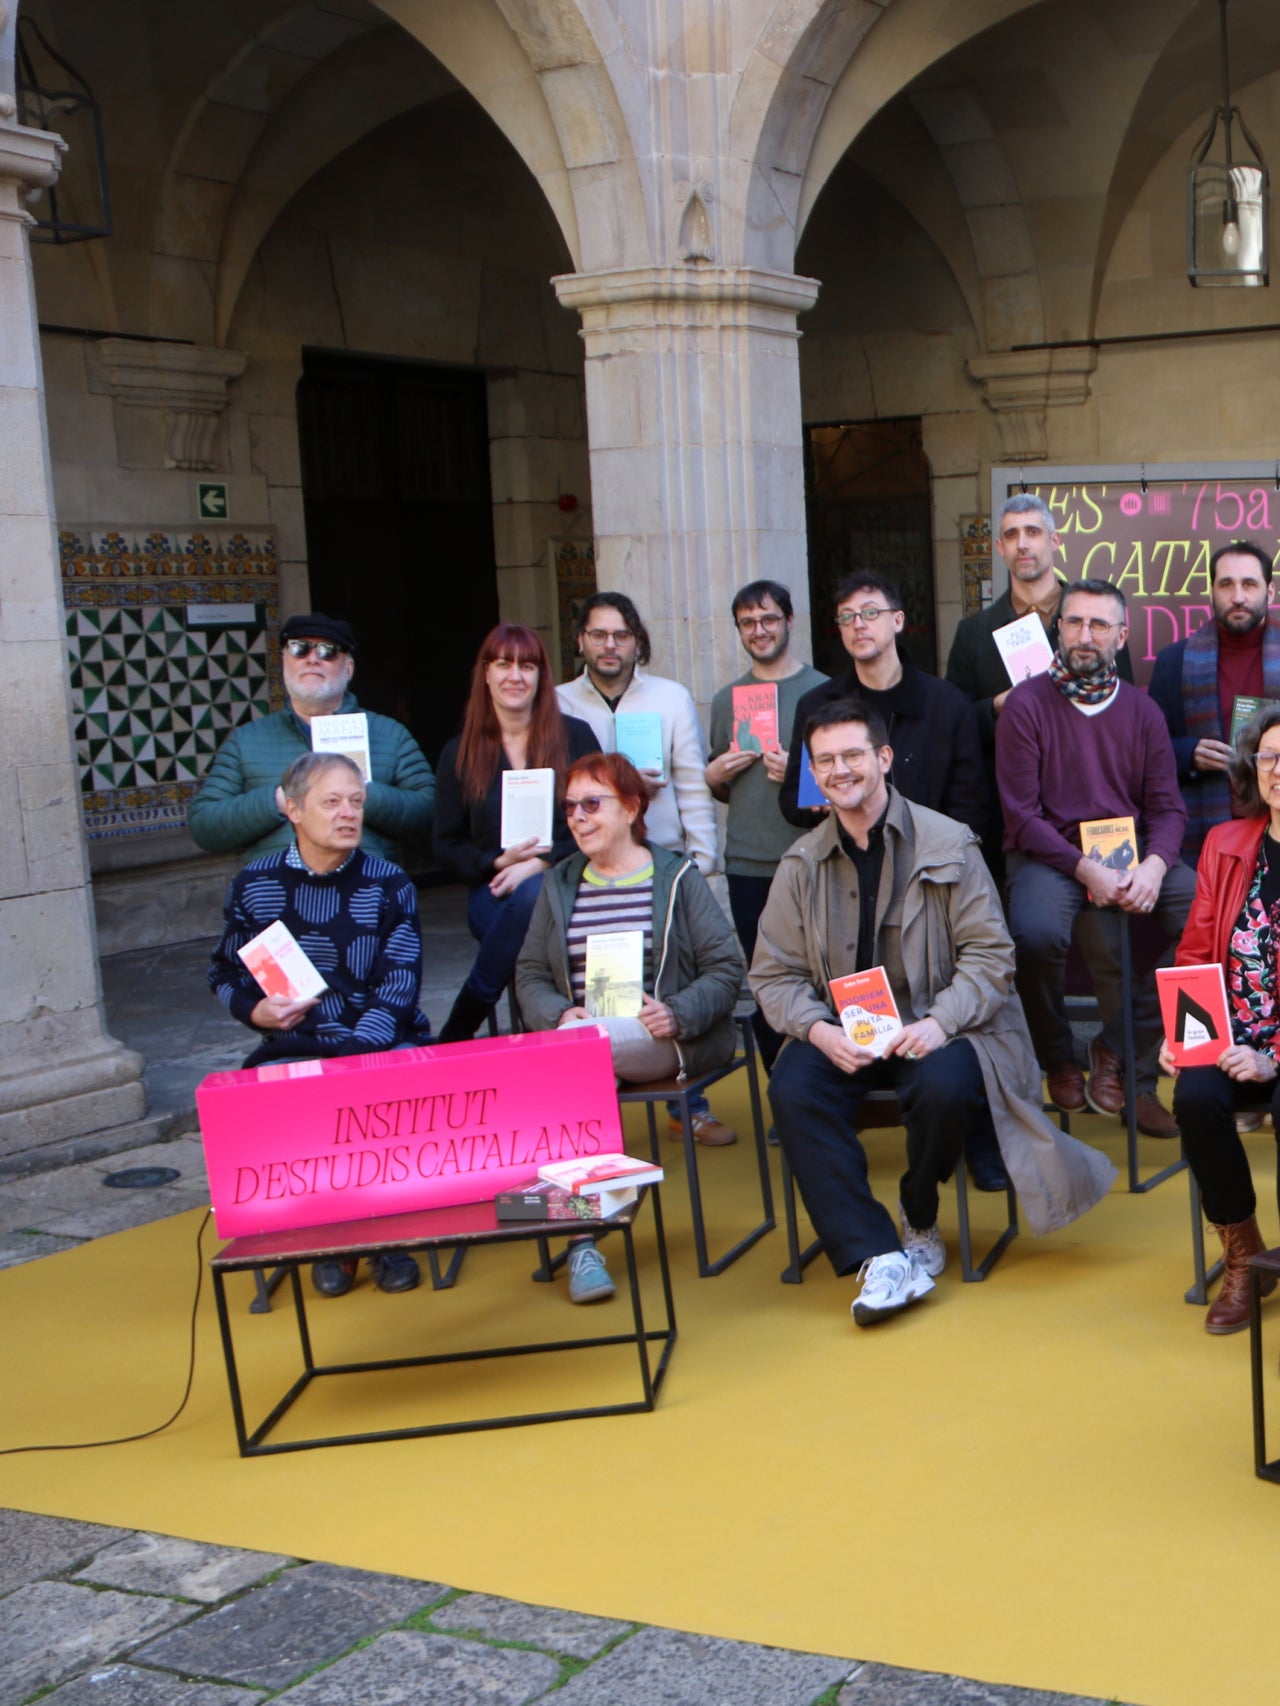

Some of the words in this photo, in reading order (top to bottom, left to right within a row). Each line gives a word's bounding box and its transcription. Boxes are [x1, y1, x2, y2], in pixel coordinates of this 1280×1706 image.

[1182, 483, 1272, 531] 75a
[844, 1007, 863, 1018] SER
[865, 1000, 888, 1013] UNA
[857, 1014, 883, 1027] PUTA
[332, 1087, 498, 1145] INSTITUT
[232, 1145, 411, 1206] D'ESTUDIS
[416, 1119, 602, 1182] CATALANS
